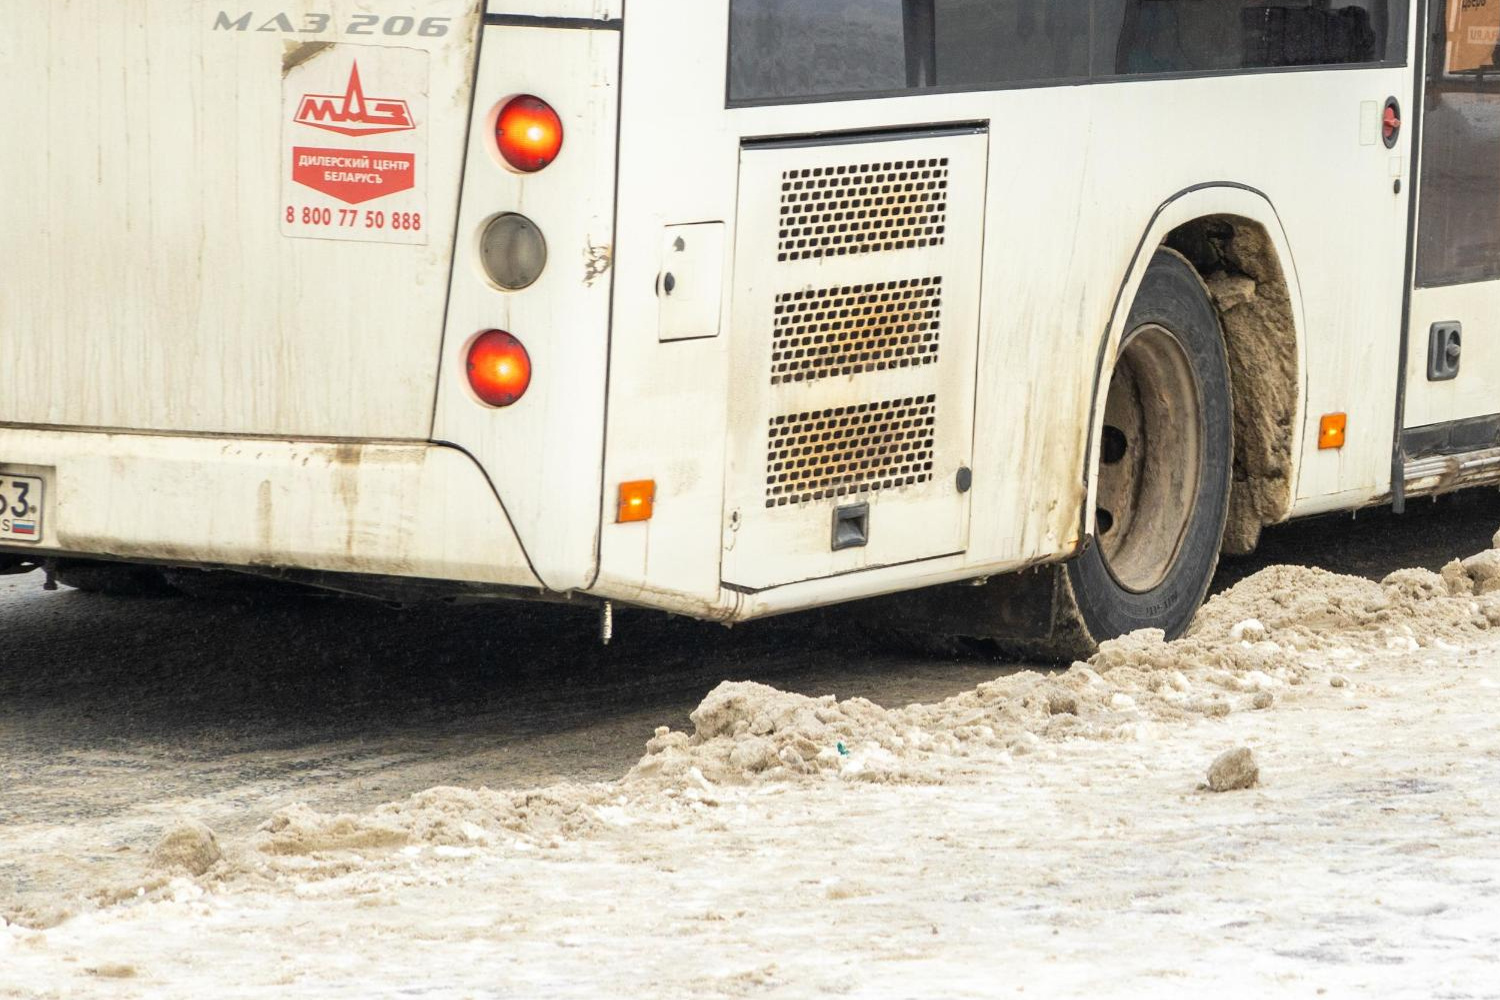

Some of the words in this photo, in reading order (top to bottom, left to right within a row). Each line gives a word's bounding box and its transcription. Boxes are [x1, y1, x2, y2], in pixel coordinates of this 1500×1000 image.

[213, 11, 331, 34] МАЗ
[345, 14, 452, 37] 206
[297, 58, 412, 130] МАЗ
[299, 154, 369, 169] ДИЛЕРСКИЙ
[373, 158, 410, 171] ЦЕНТР
[286, 205, 295, 224] 8
[302, 206, 332, 226] 800
[339, 208, 359, 228] 77
[365, 210, 385, 229] 50
[391, 212, 421, 231] 888
